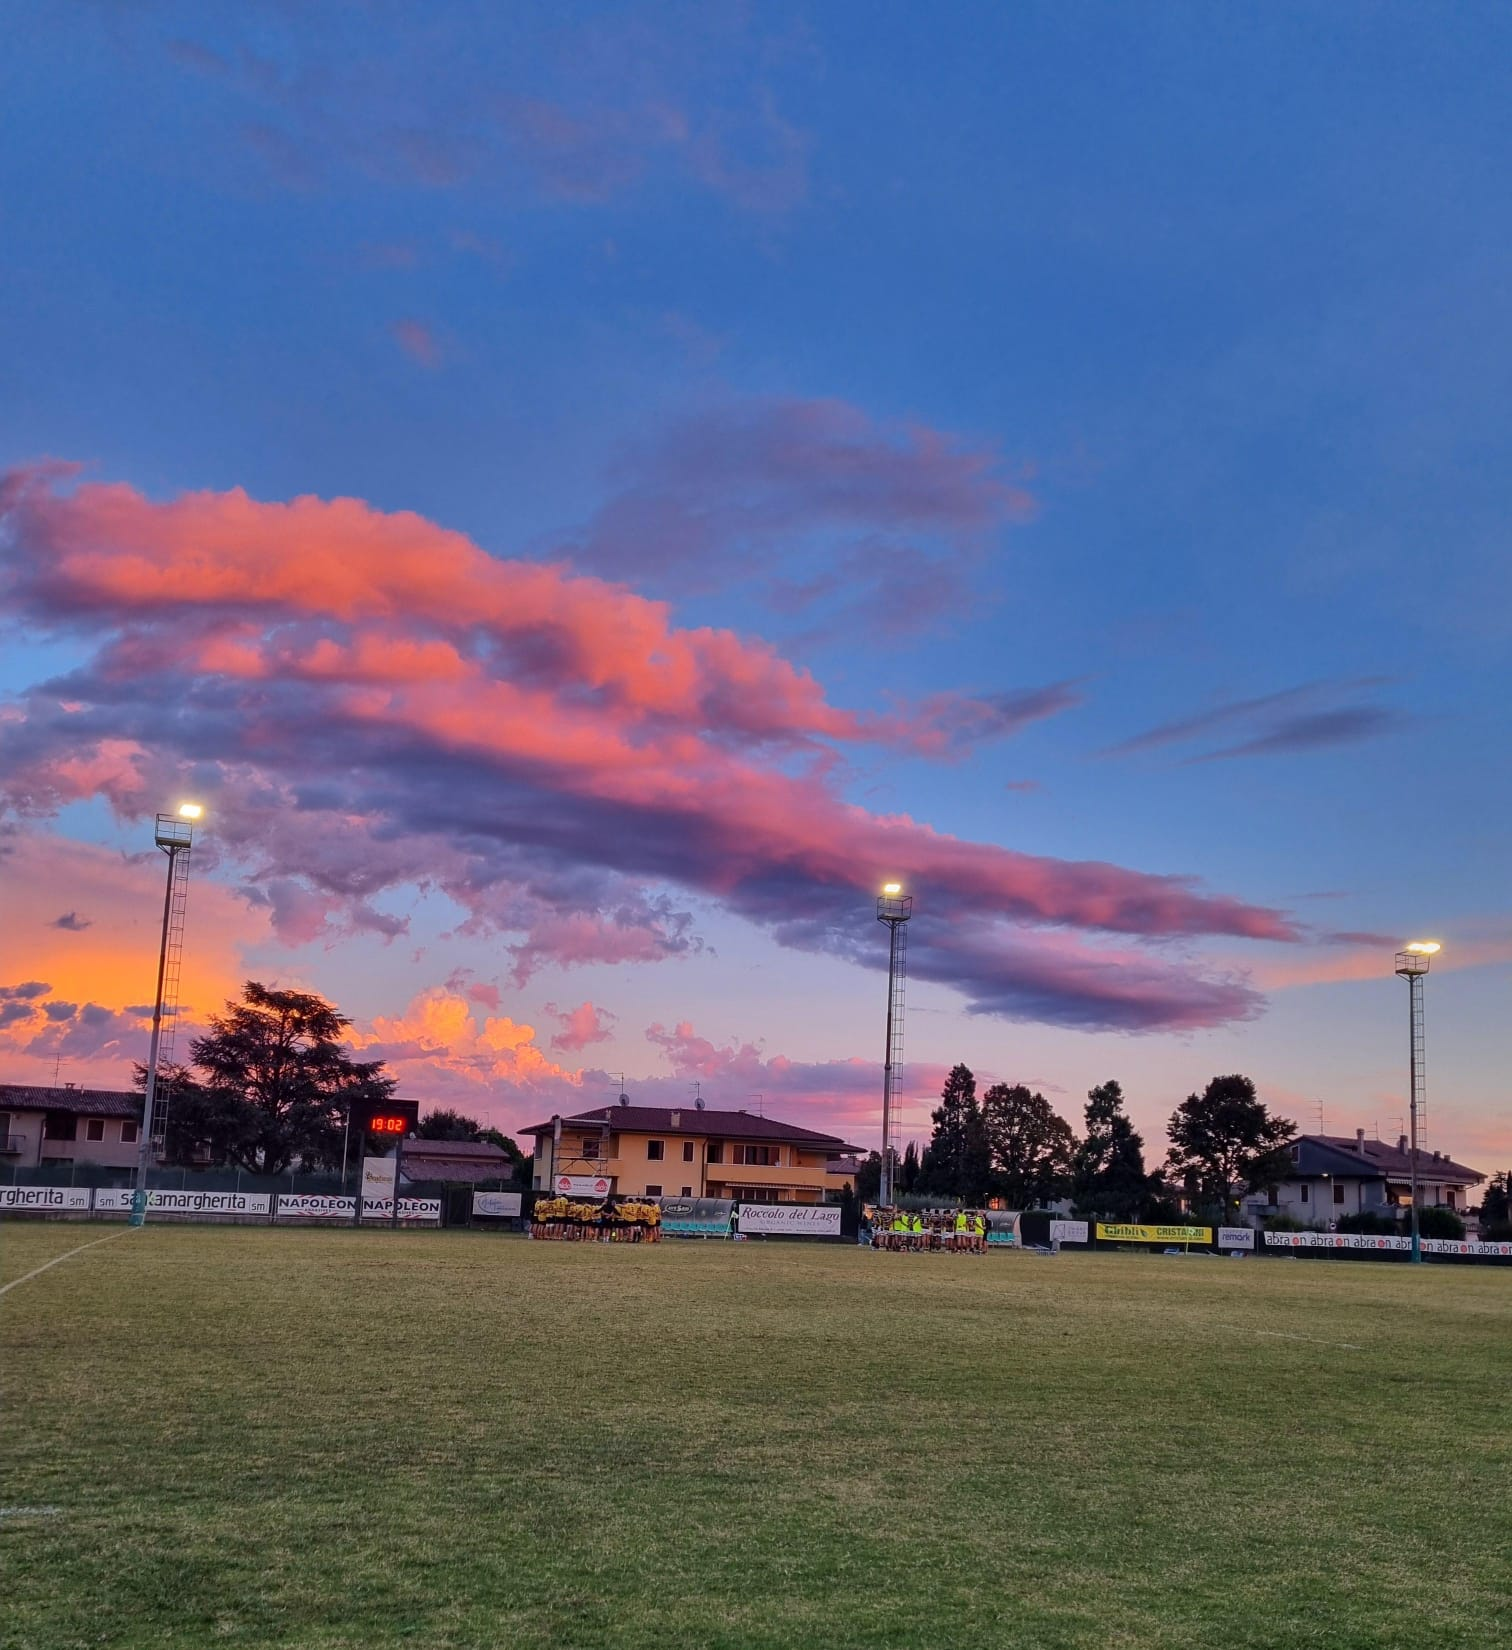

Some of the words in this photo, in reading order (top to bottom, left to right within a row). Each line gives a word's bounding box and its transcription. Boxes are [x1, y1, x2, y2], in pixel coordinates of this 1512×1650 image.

[372, 1118, 403, 1131] 19:02
[70, 1197, 85, 1206] sm
[99, 1198, 114, 1207] sm
[120, 1191, 246, 1210] satamargherita
[279, 1198, 356, 1210] NAPOLEON
[251, 1202, 265, 1211] sm
[741, 1207, 785, 1220] Roccolo
[788, 1208, 808, 1220] del
[811, 1209, 840, 1224] Lago
[1156, 1227, 1205, 1237] CRISTANI
